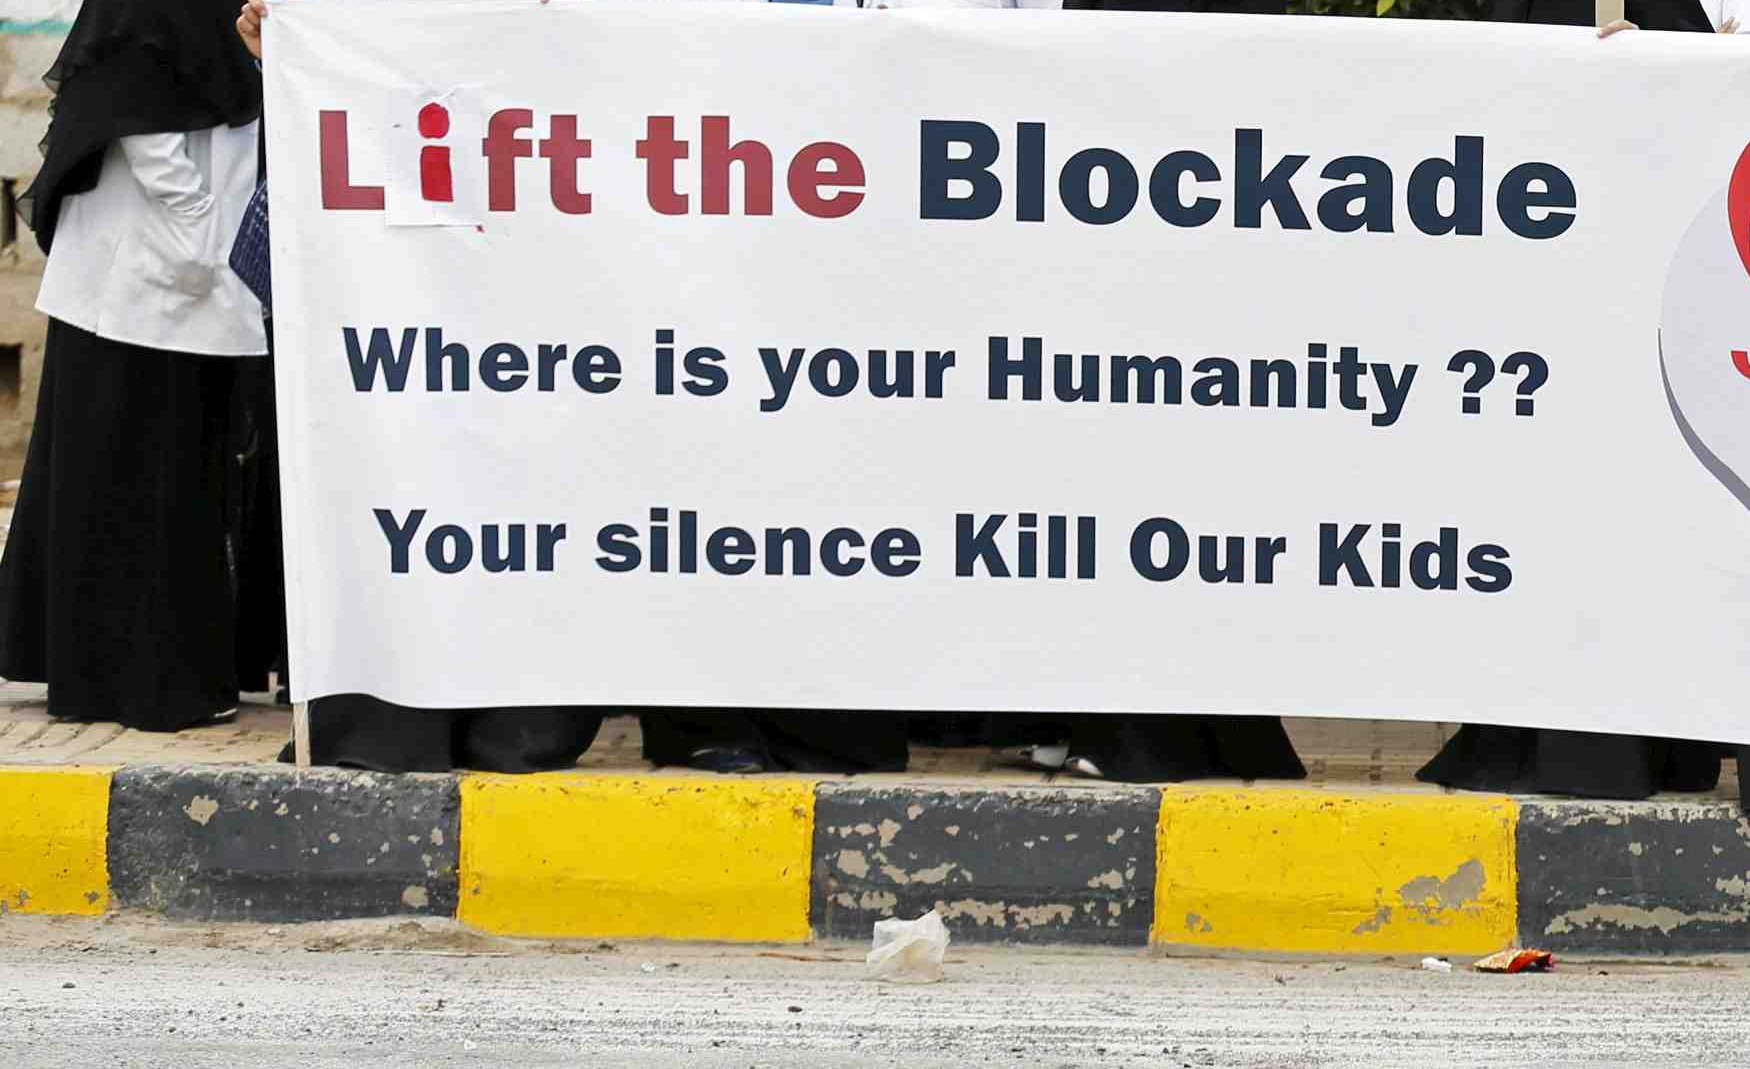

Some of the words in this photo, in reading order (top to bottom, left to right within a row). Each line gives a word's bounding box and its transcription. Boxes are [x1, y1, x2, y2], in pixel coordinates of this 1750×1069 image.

[319, 105, 592, 214] Lift
[635, 115, 866, 219] the
[919, 119, 1577, 240] Blockade
[341, 326, 622, 395] Where
[655, 329, 729, 397] is
[757, 347, 956, 413] your
[987, 335, 1419, 428] Humanity
[1446, 349, 1549, 417] ??
[372, 508, 567, 575] Your
[594, 506, 922, 578] silence
[955, 512, 1097, 580] Kill
[1129, 516, 1287, 585] Our
[1318, 522, 1513, 594] Kids
